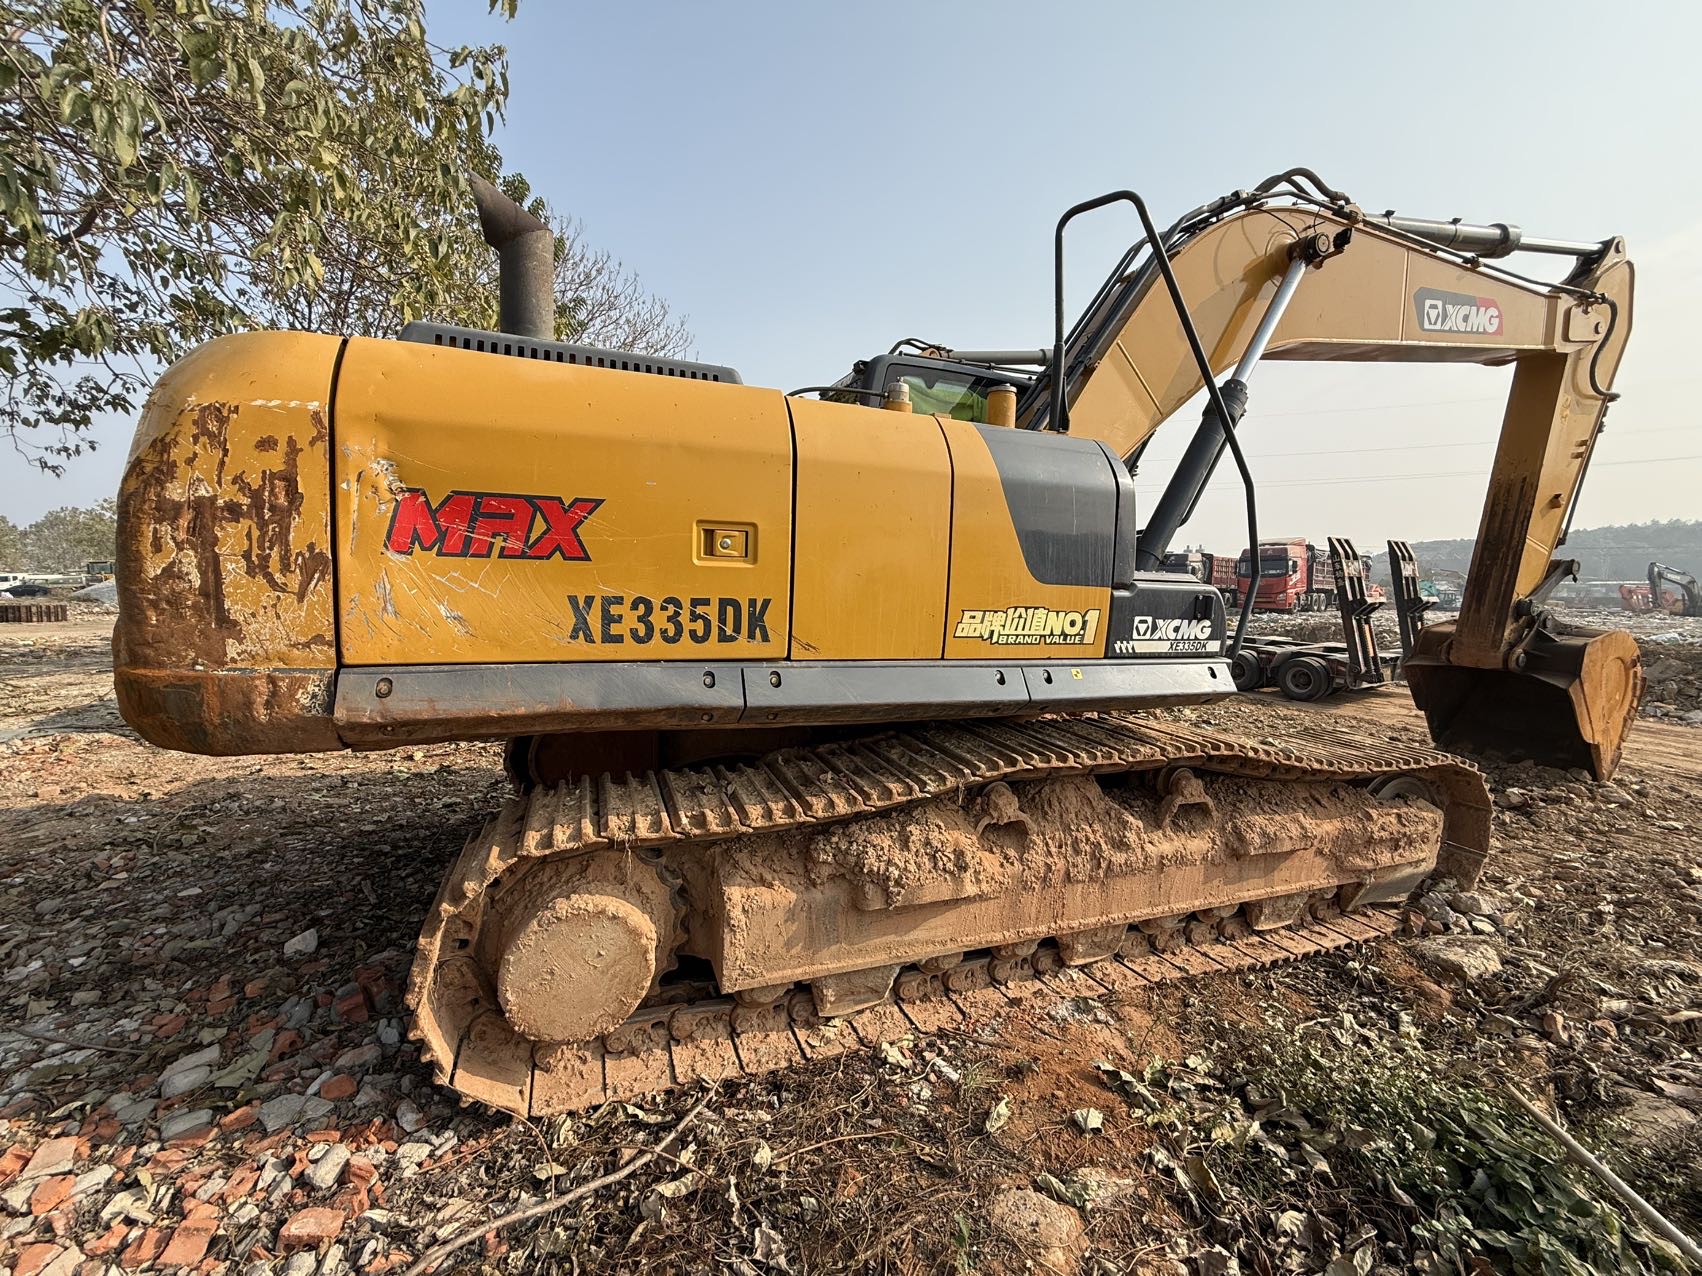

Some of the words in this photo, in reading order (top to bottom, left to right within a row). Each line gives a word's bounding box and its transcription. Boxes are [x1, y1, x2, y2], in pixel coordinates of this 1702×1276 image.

[1441, 304, 1500, 333] XCMG
[382, 487, 606, 562] MAX
[566, 594, 773, 645] XE335DK
[1150, 619, 1212, 640] XCMG
[998, 635, 1040, 644] BRAND
[1045, 635, 1082, 644] VALUE
[1168, 641, 1209, 652] XE335DK
